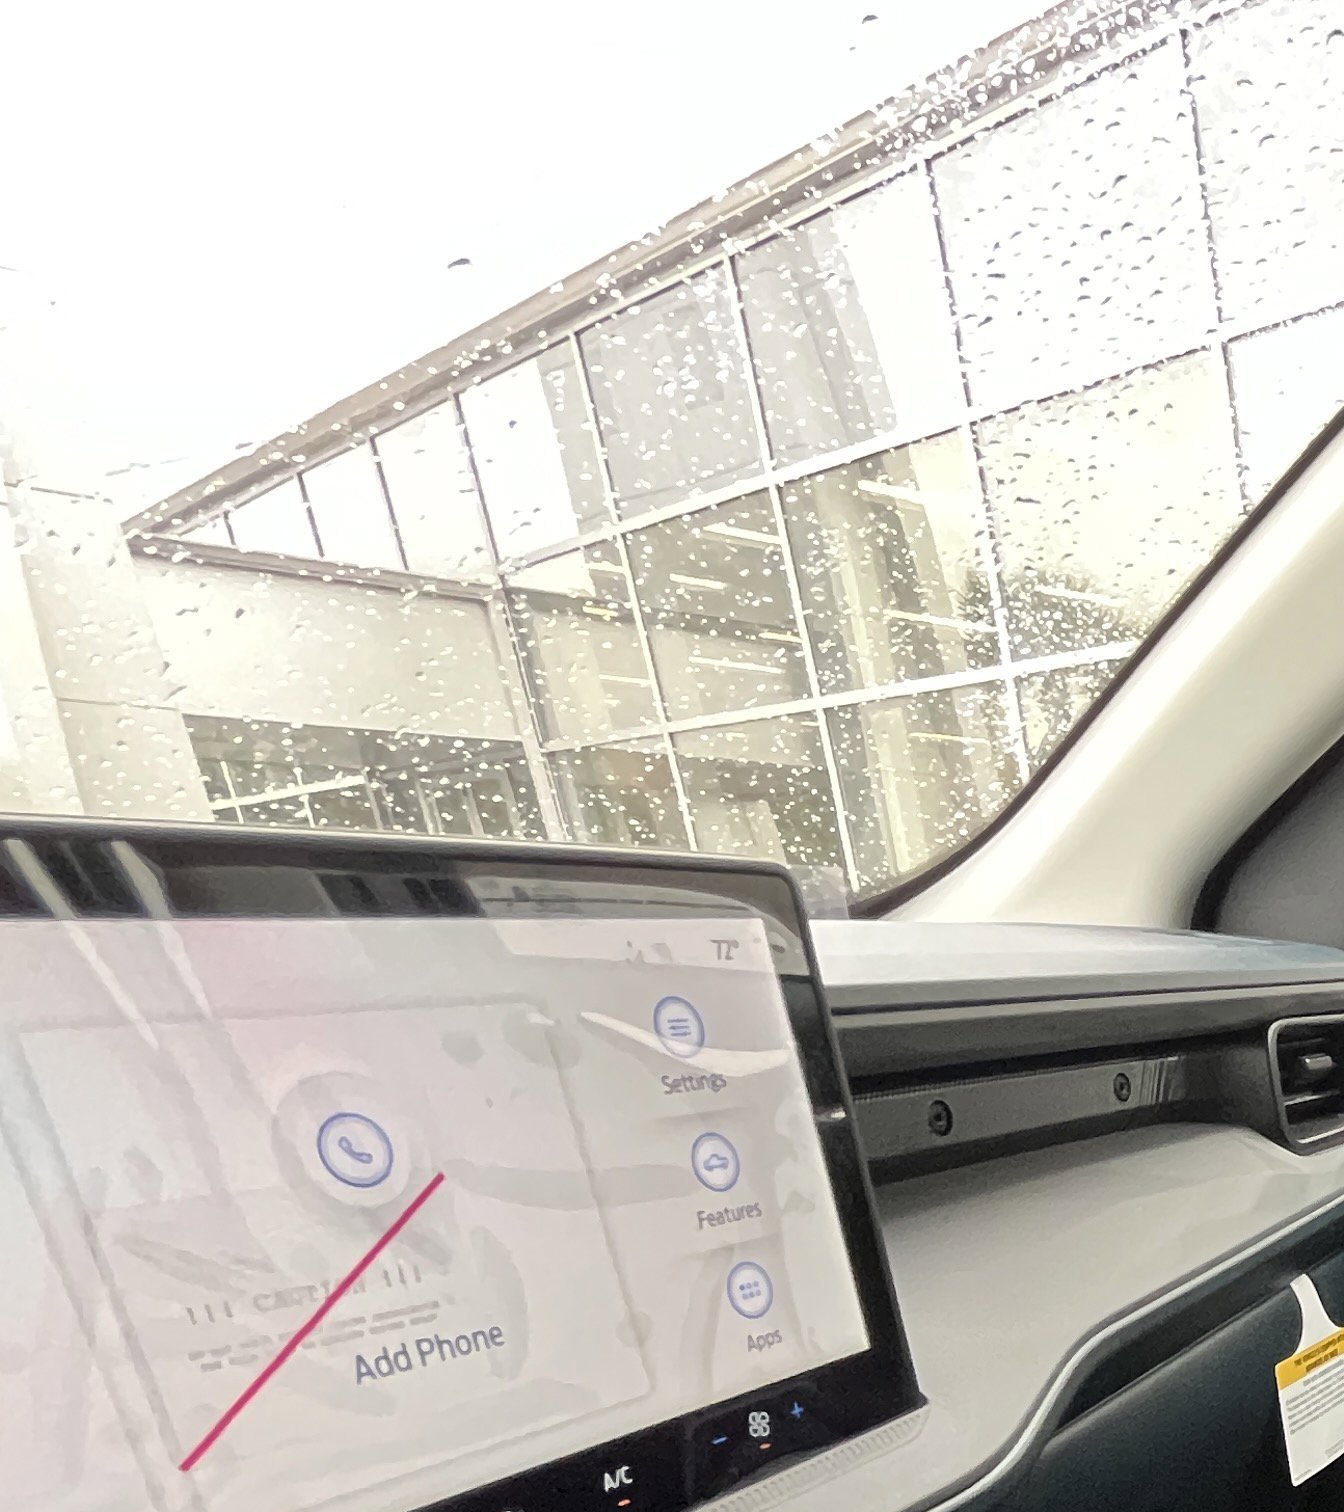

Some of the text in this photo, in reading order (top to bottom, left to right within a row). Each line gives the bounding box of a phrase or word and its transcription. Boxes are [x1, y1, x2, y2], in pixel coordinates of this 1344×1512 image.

[660, 1073, 728, 1096] Settings
[696, 1202, 763, 1232] Features
[747, 1329, 783, 1352] Apps
[354, 1342, 413, 1384] Add
[416, 1325, 506, 1367] Phone
[603, 1465, 634, 1492] A/C
